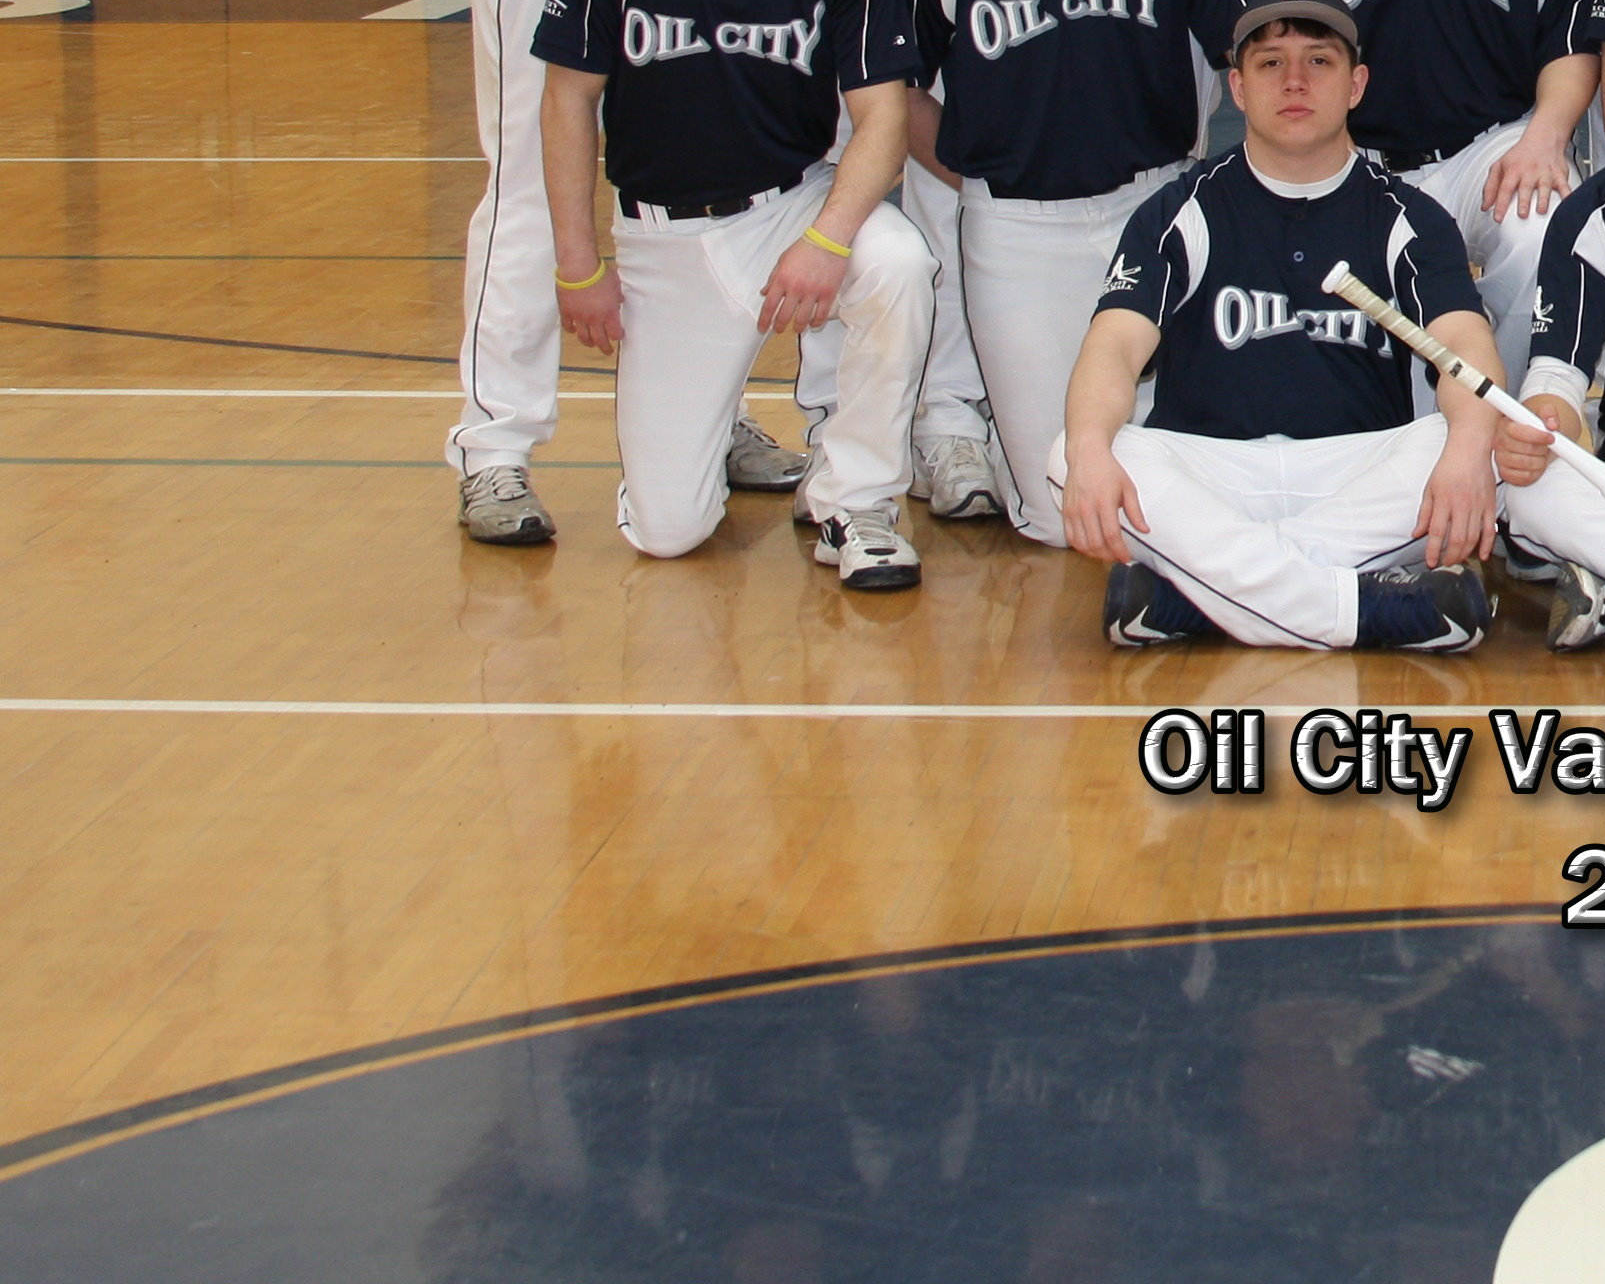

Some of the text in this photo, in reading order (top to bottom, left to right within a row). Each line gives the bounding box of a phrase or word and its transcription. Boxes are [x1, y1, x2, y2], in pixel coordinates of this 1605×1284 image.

[623, 0, 827, 76] OIL CITY
[1215, 285, 1396, 359] OIL CIT
